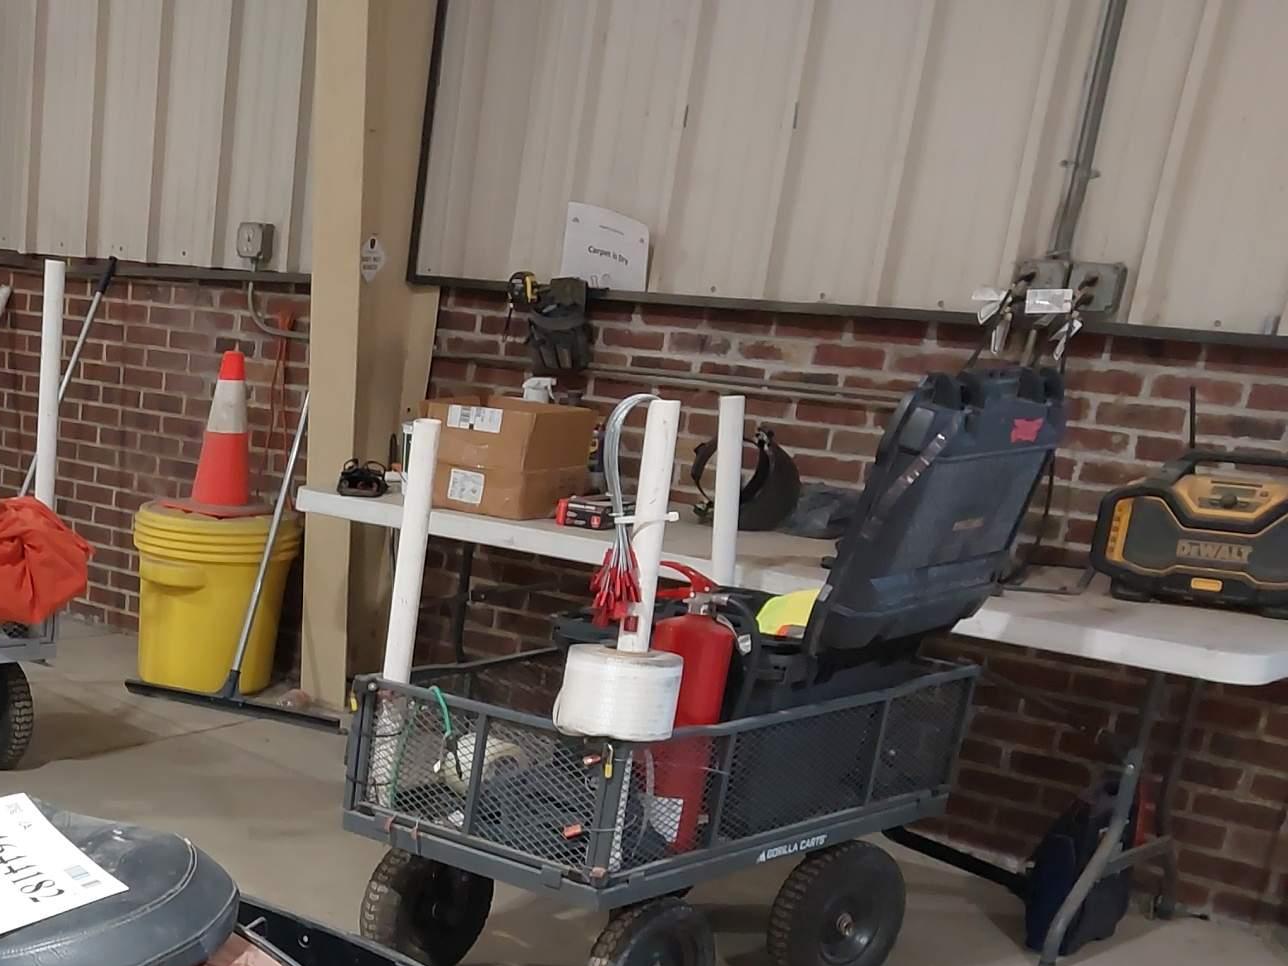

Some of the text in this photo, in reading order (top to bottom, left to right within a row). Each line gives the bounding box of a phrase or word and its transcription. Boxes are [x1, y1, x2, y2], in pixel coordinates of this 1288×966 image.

[587, 245, 611, 258] Carpet
[618, 254, 629, 266] Dry
[766, 842, 798, 859] GORILLA
